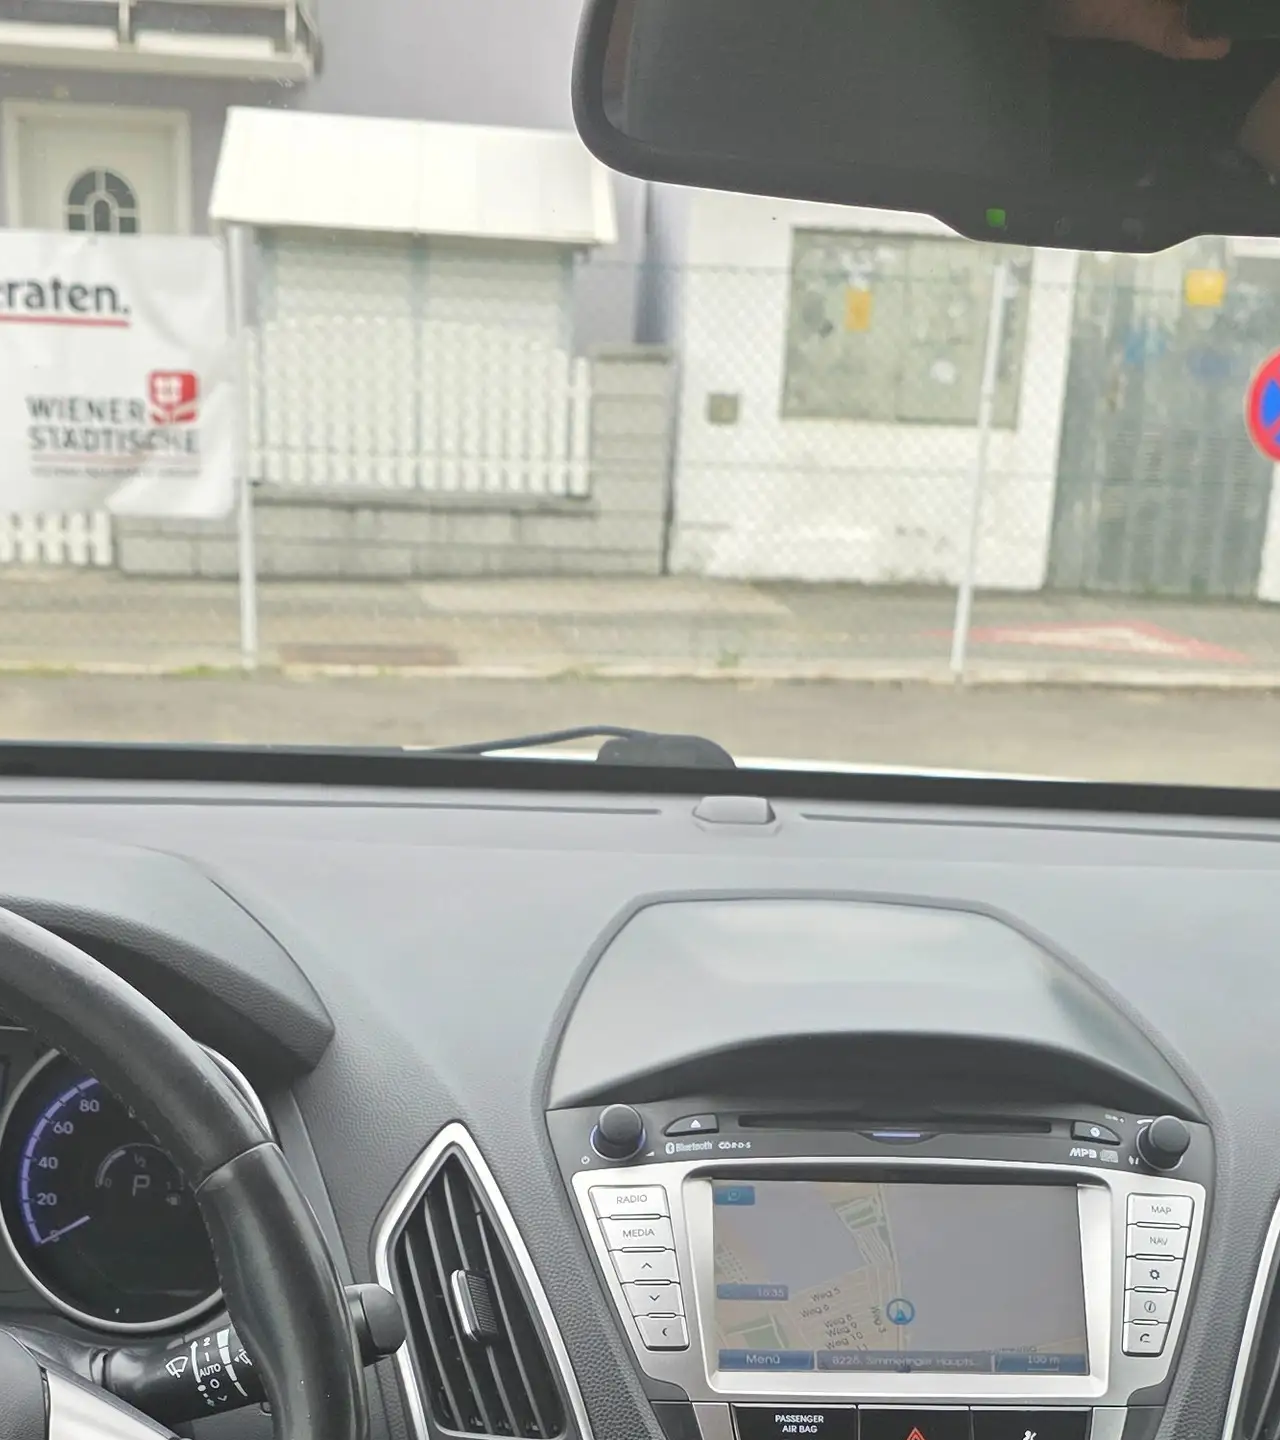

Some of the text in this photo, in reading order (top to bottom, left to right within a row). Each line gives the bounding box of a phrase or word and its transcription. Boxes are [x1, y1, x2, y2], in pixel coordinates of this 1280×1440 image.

[24, 394, 147, 425] WIENER
[79, 1099, 100, 1113] 80
[52, 1121, 74, 1136] 60
[37, 1156, 59, 1171] 40
[131, 1174, 151, 1197] P
[36, 1193, 58, 1207] 20
[616, 1193, 648, 1205] RADIO
[1150, 1205, 1172, 1215] MAP
[622, 1228, 656, 1239] MEDIA
[1149, 1236, 1168, 1246] NAV
[202, 1336, 211, 1347] 2
[199, 1362, 222, 1378] AUTO
[774, 1414, 825, 1424] PASSENGER
[781, 1424, 818, 1434] AIR BAG
